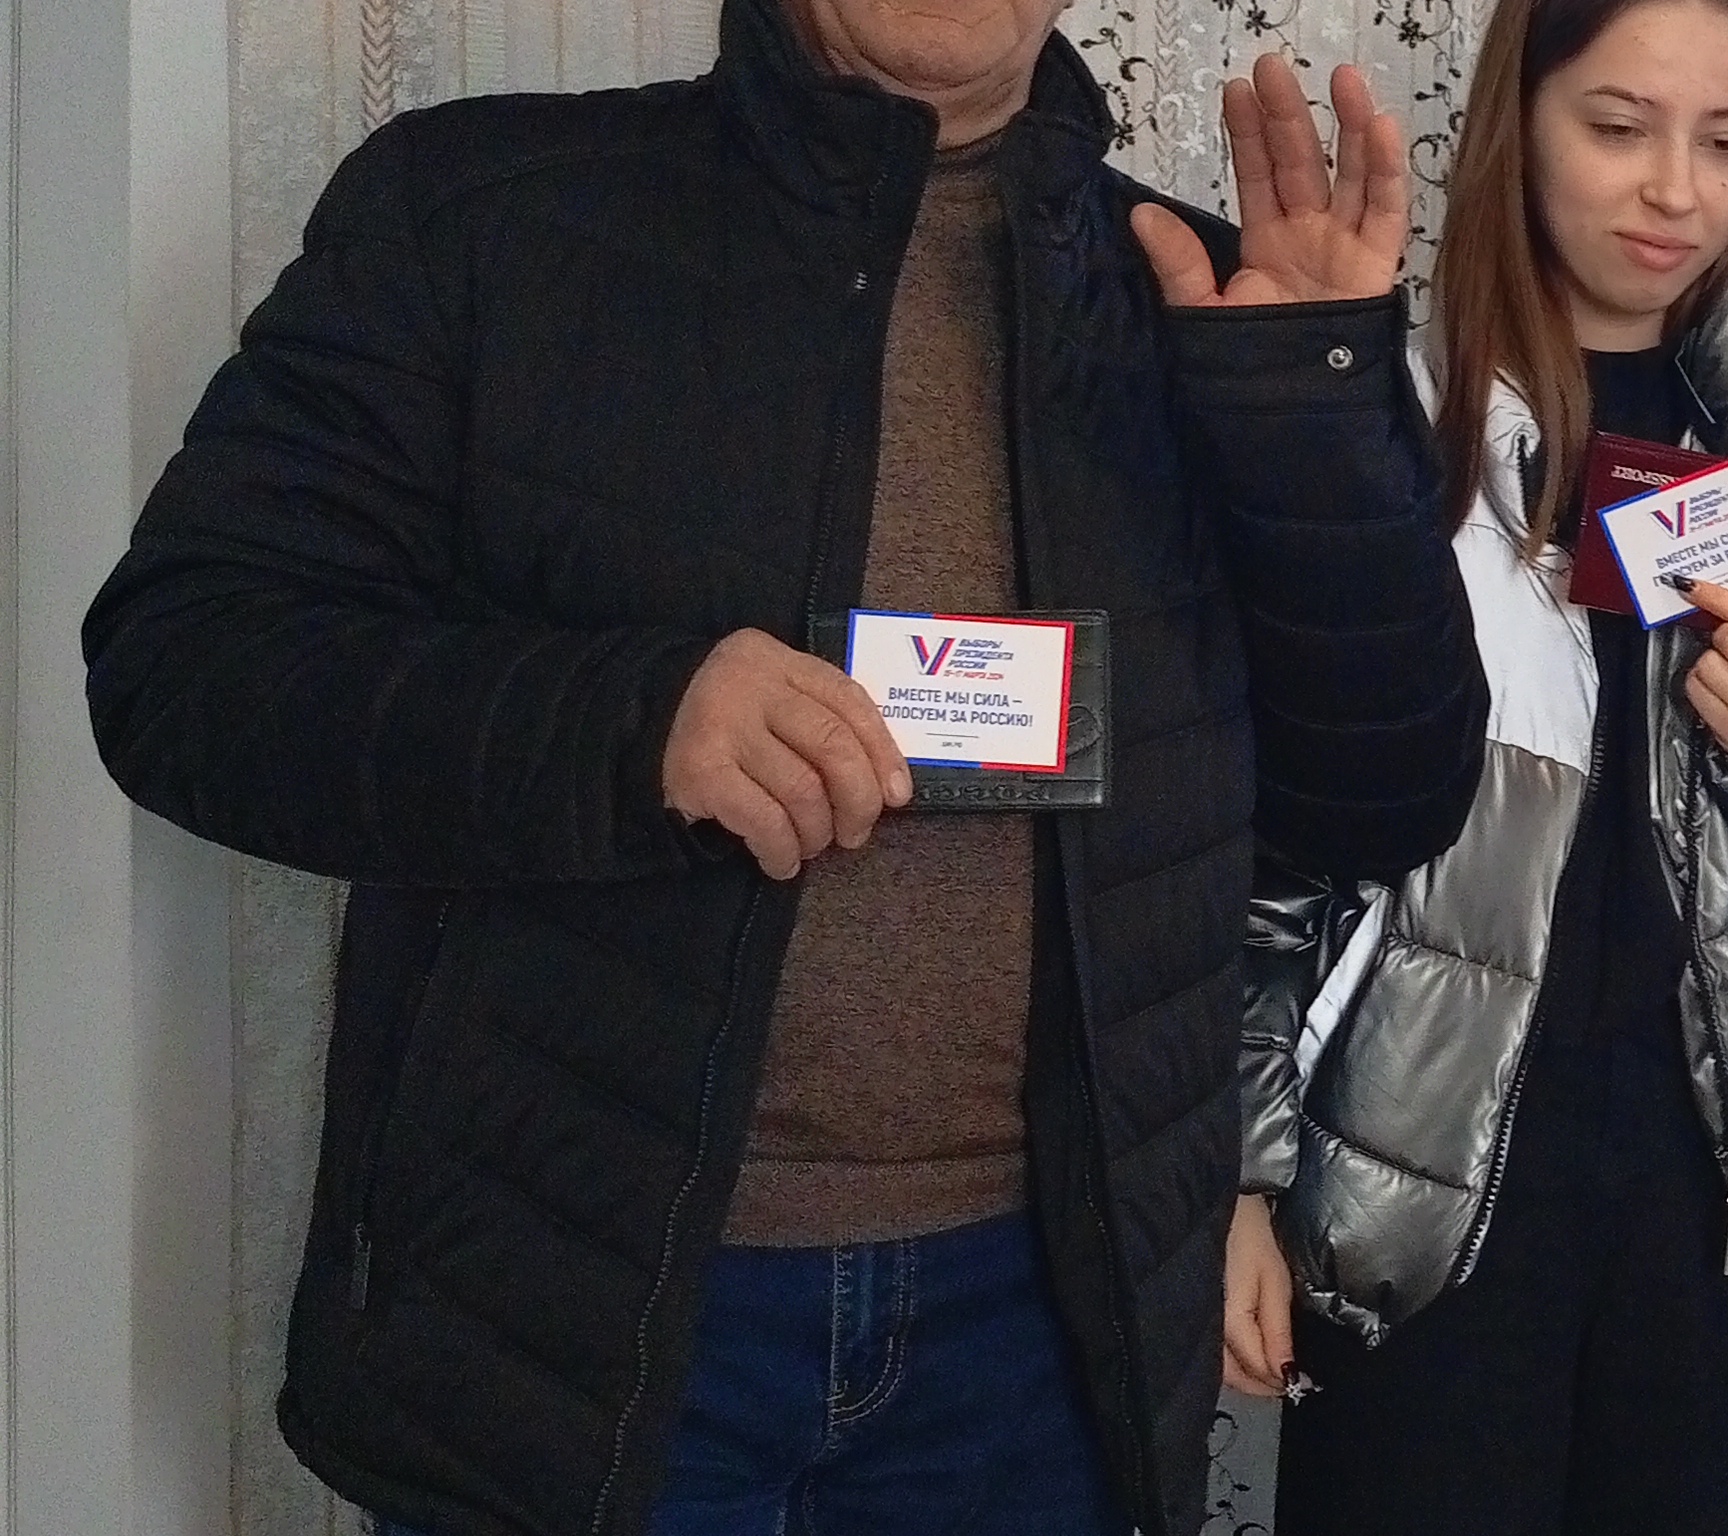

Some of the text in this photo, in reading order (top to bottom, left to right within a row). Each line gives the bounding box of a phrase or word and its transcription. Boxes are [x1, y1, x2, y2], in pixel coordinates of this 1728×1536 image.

[888, 687, 942, 703] ВМЕСТЕ
[944, 691, 970, 705] МЫ
[973, 692, 1010, 707] СИЛА
[949, 709, 968, 723] ЗА
[970, 711, 1034, 728] РОССИЮ!
